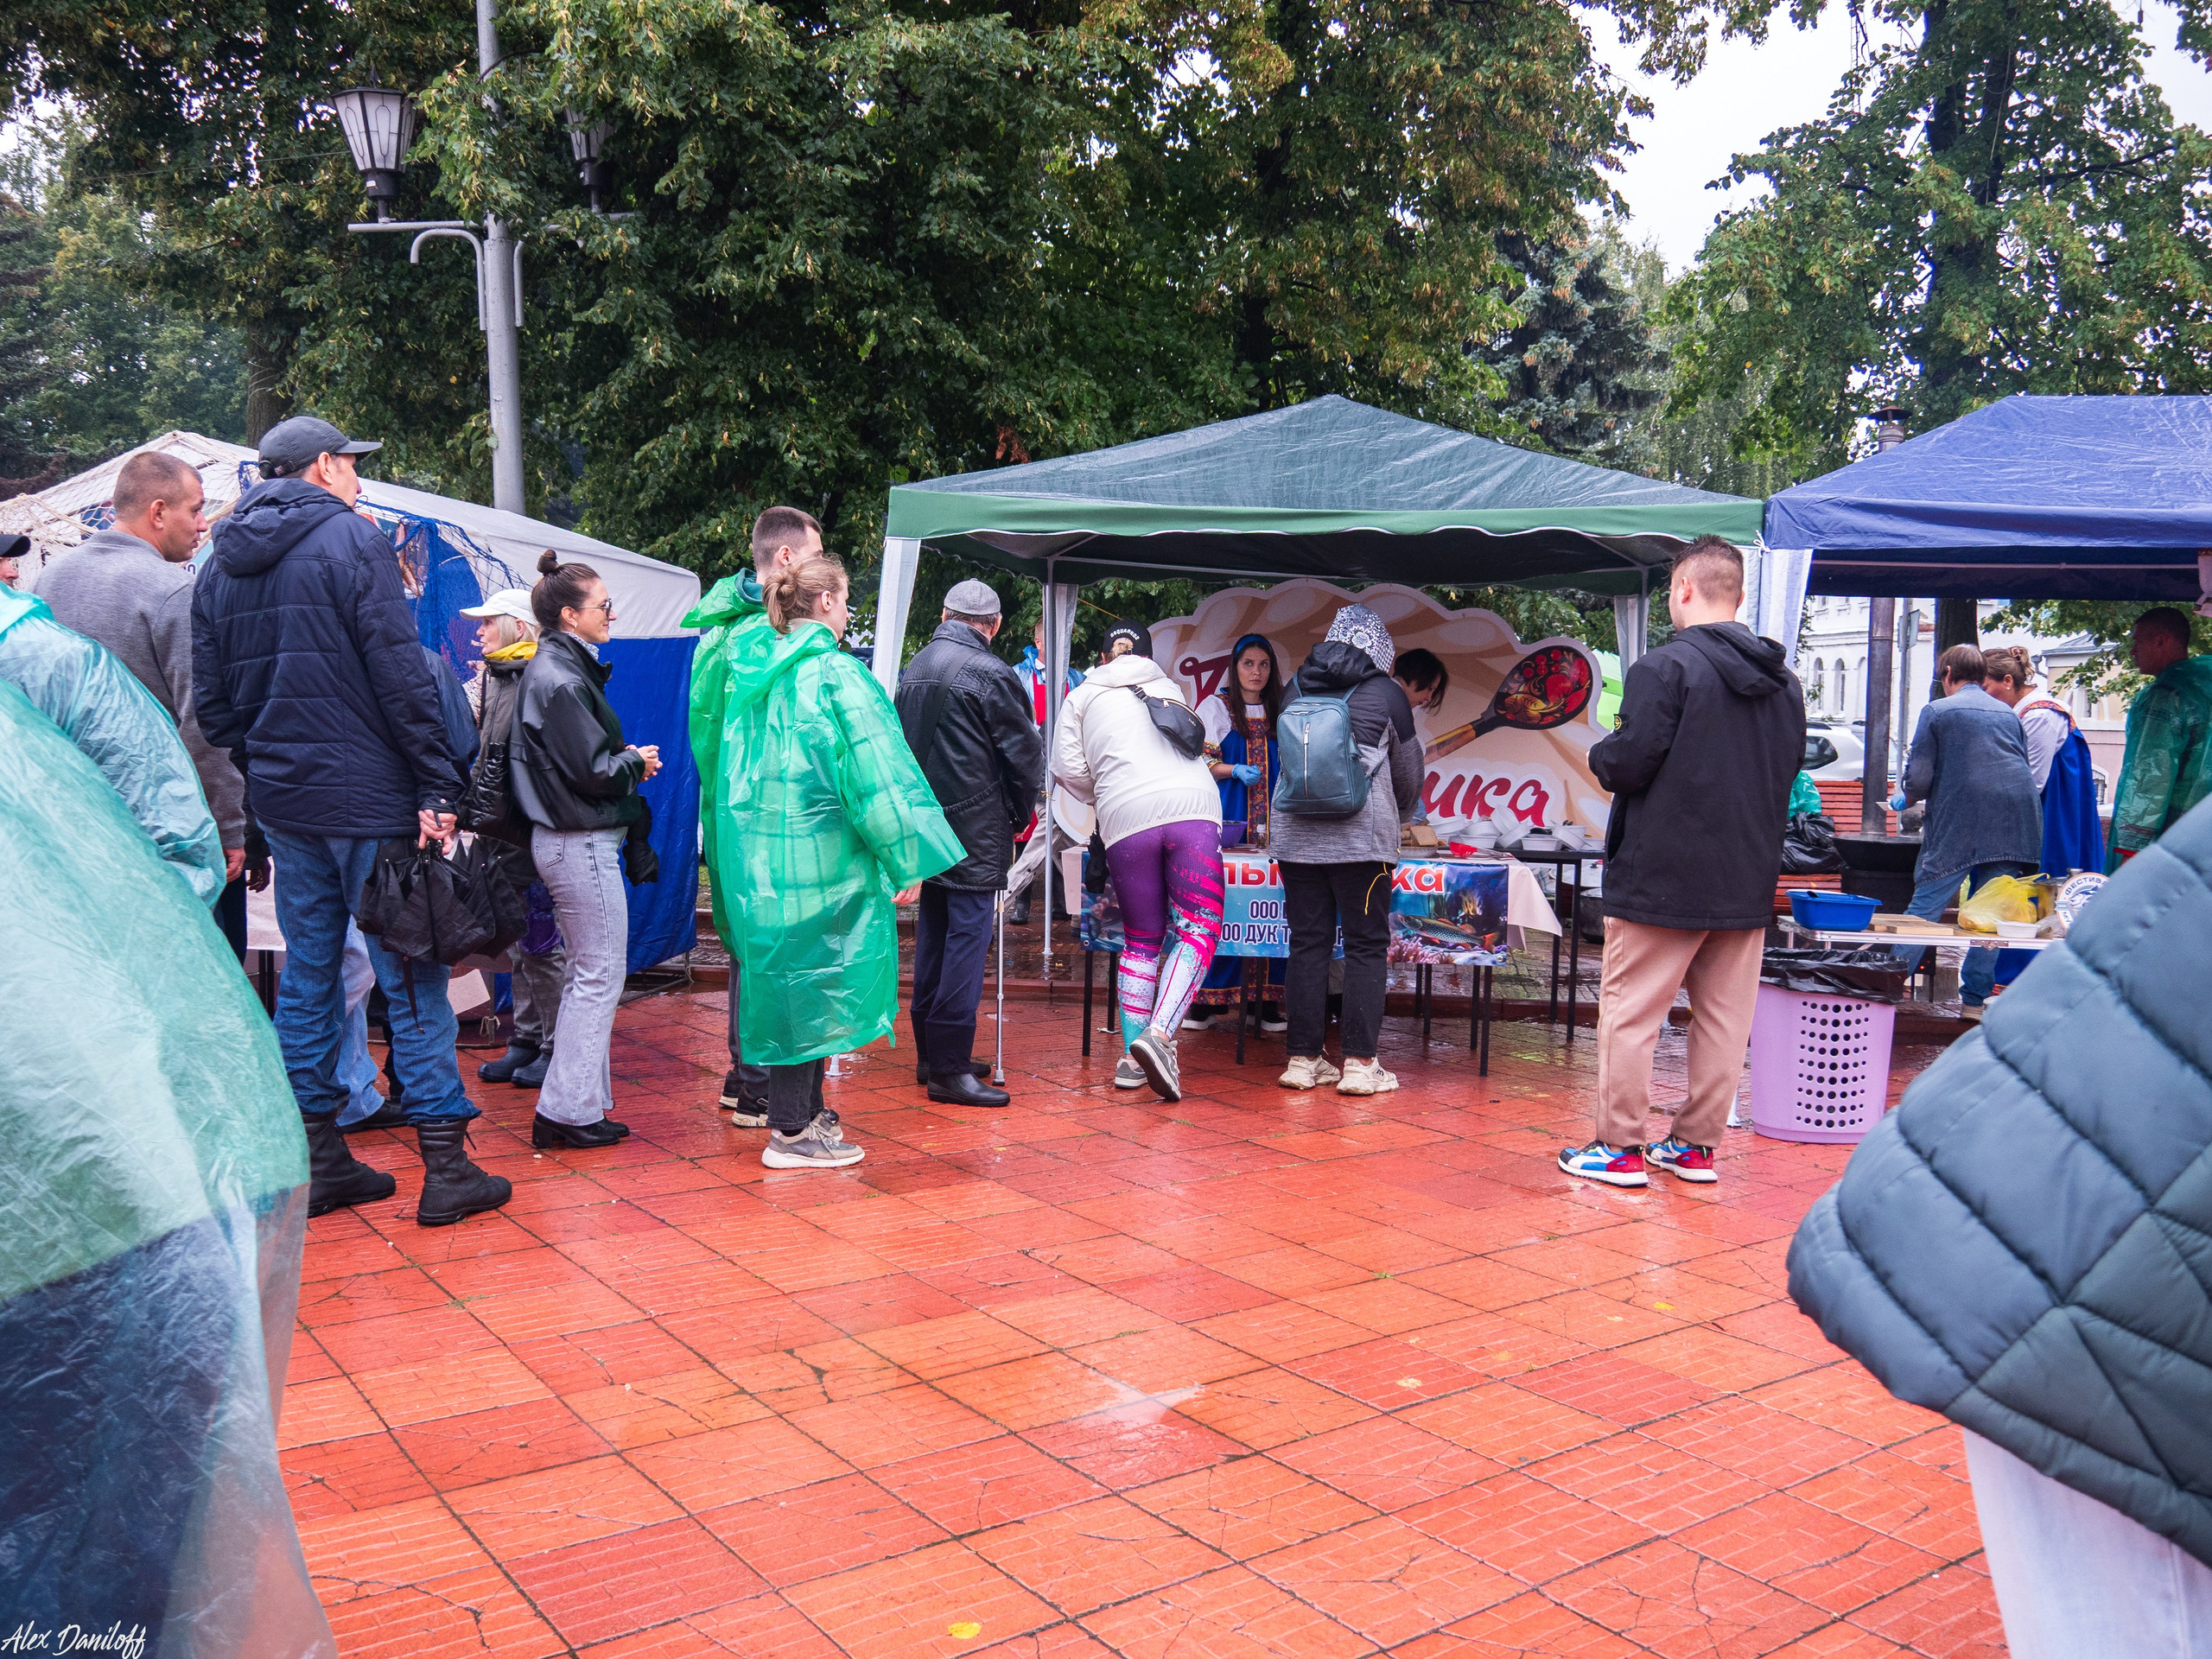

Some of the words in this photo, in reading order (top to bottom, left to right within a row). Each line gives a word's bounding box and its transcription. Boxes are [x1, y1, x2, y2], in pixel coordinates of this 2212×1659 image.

[2064, 876, 2107, 896] ФЕСТИВ
[1221, 923, 1242, 942] ОО
[1244, 924, 1278, 944] ДУК
